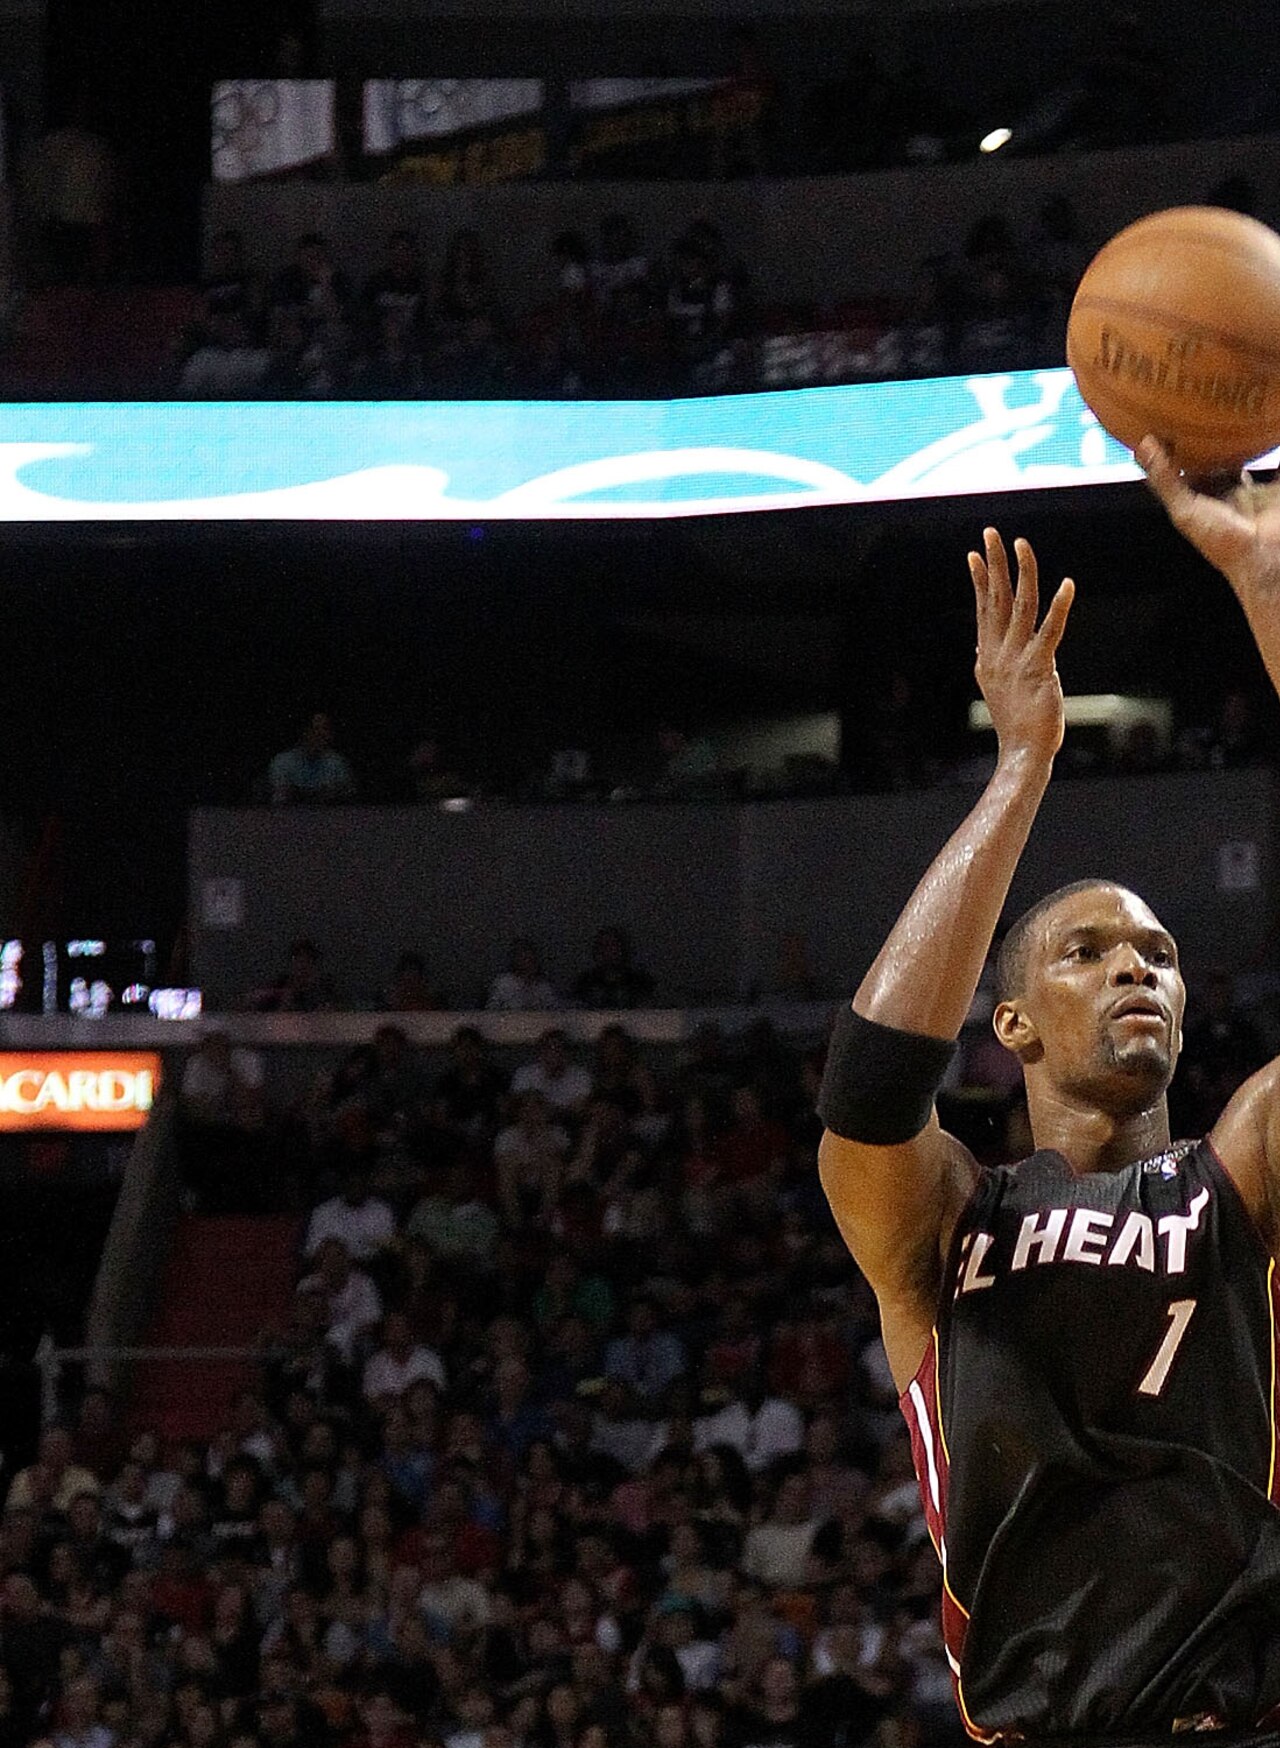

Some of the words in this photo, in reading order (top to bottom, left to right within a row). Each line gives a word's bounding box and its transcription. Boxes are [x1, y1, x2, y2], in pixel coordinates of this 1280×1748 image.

[0, 1069, 153, 1113] CARDI
[1012, 1187, 1209, 1274] HEAT
[1138, 1299, 1197, 1397] 1
